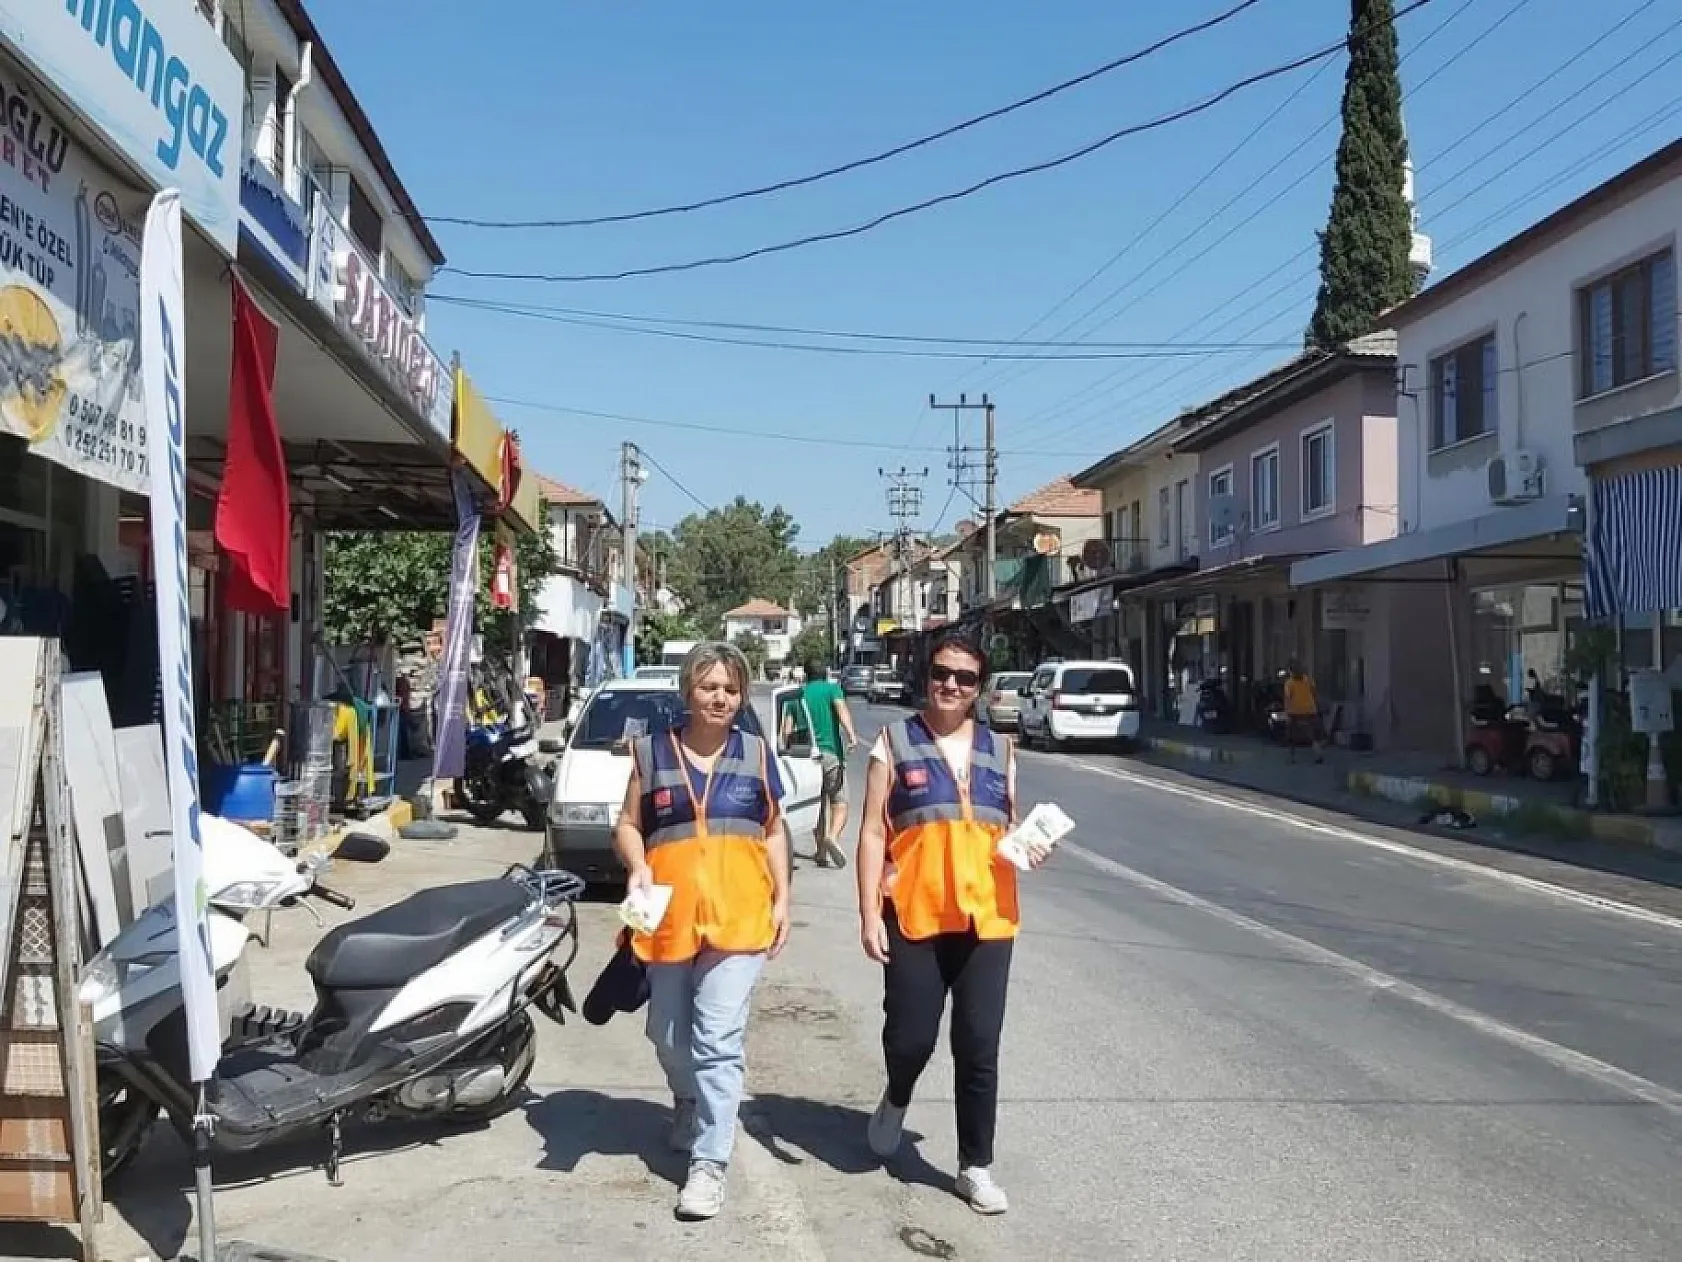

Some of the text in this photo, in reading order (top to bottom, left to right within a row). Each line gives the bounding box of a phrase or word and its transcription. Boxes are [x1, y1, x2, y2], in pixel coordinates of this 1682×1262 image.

[38, 218, 73, 268] ÖZEL
[26, 251, 55, 289] TÜP
[69, 393, 78, 416] 0
[121, 446, 134, 472] 70
